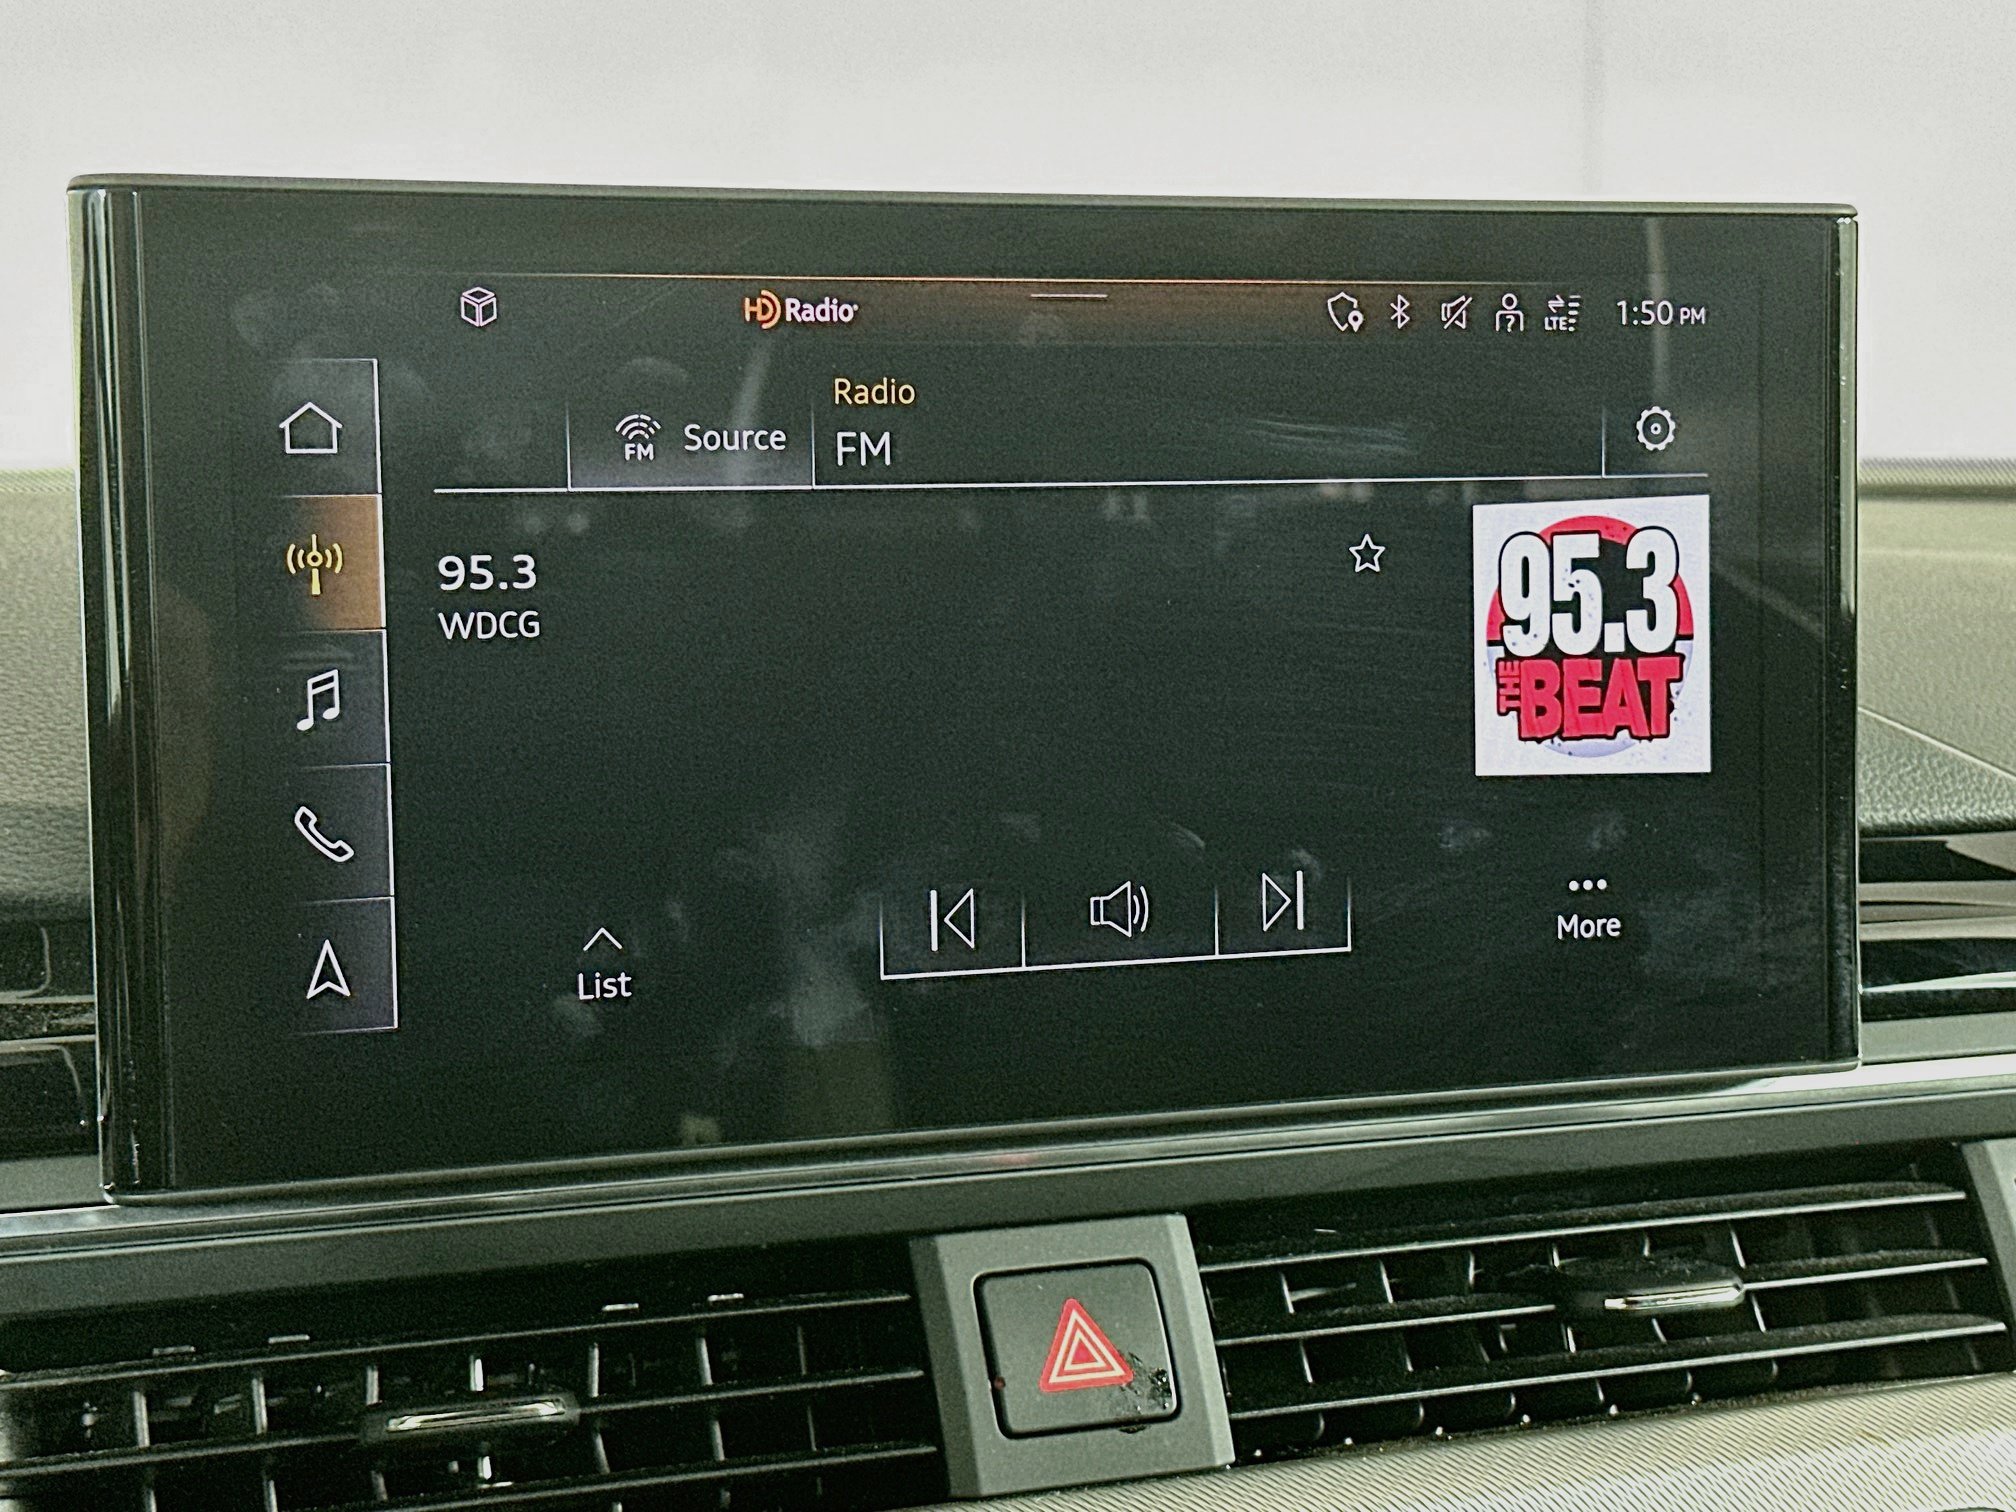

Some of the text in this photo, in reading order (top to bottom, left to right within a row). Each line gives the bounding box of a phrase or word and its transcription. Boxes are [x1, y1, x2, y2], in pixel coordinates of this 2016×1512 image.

[785, 296, 858, 323] Radio
[1544, 316, 1568, 332] LTE
[1616, 300, 1706, 326] 1:50 PM
[834, 376, 915, 405] Radio
[624, 442, 654, 461] FM
[684, 423, 787, 452] Source
[836, 431, 891, 467] FM
[438, 554, 537, 591] 95.3
[1499, 525, 1680, 658] 95.3
[438, 610, 540, 640] WDCG
[1498, 659, 1521, 714] THE
[1519, 656, 1682, 739] BEAT
[1557, 913, 1622, 940] More
[578, 971, 633, 1001] List
